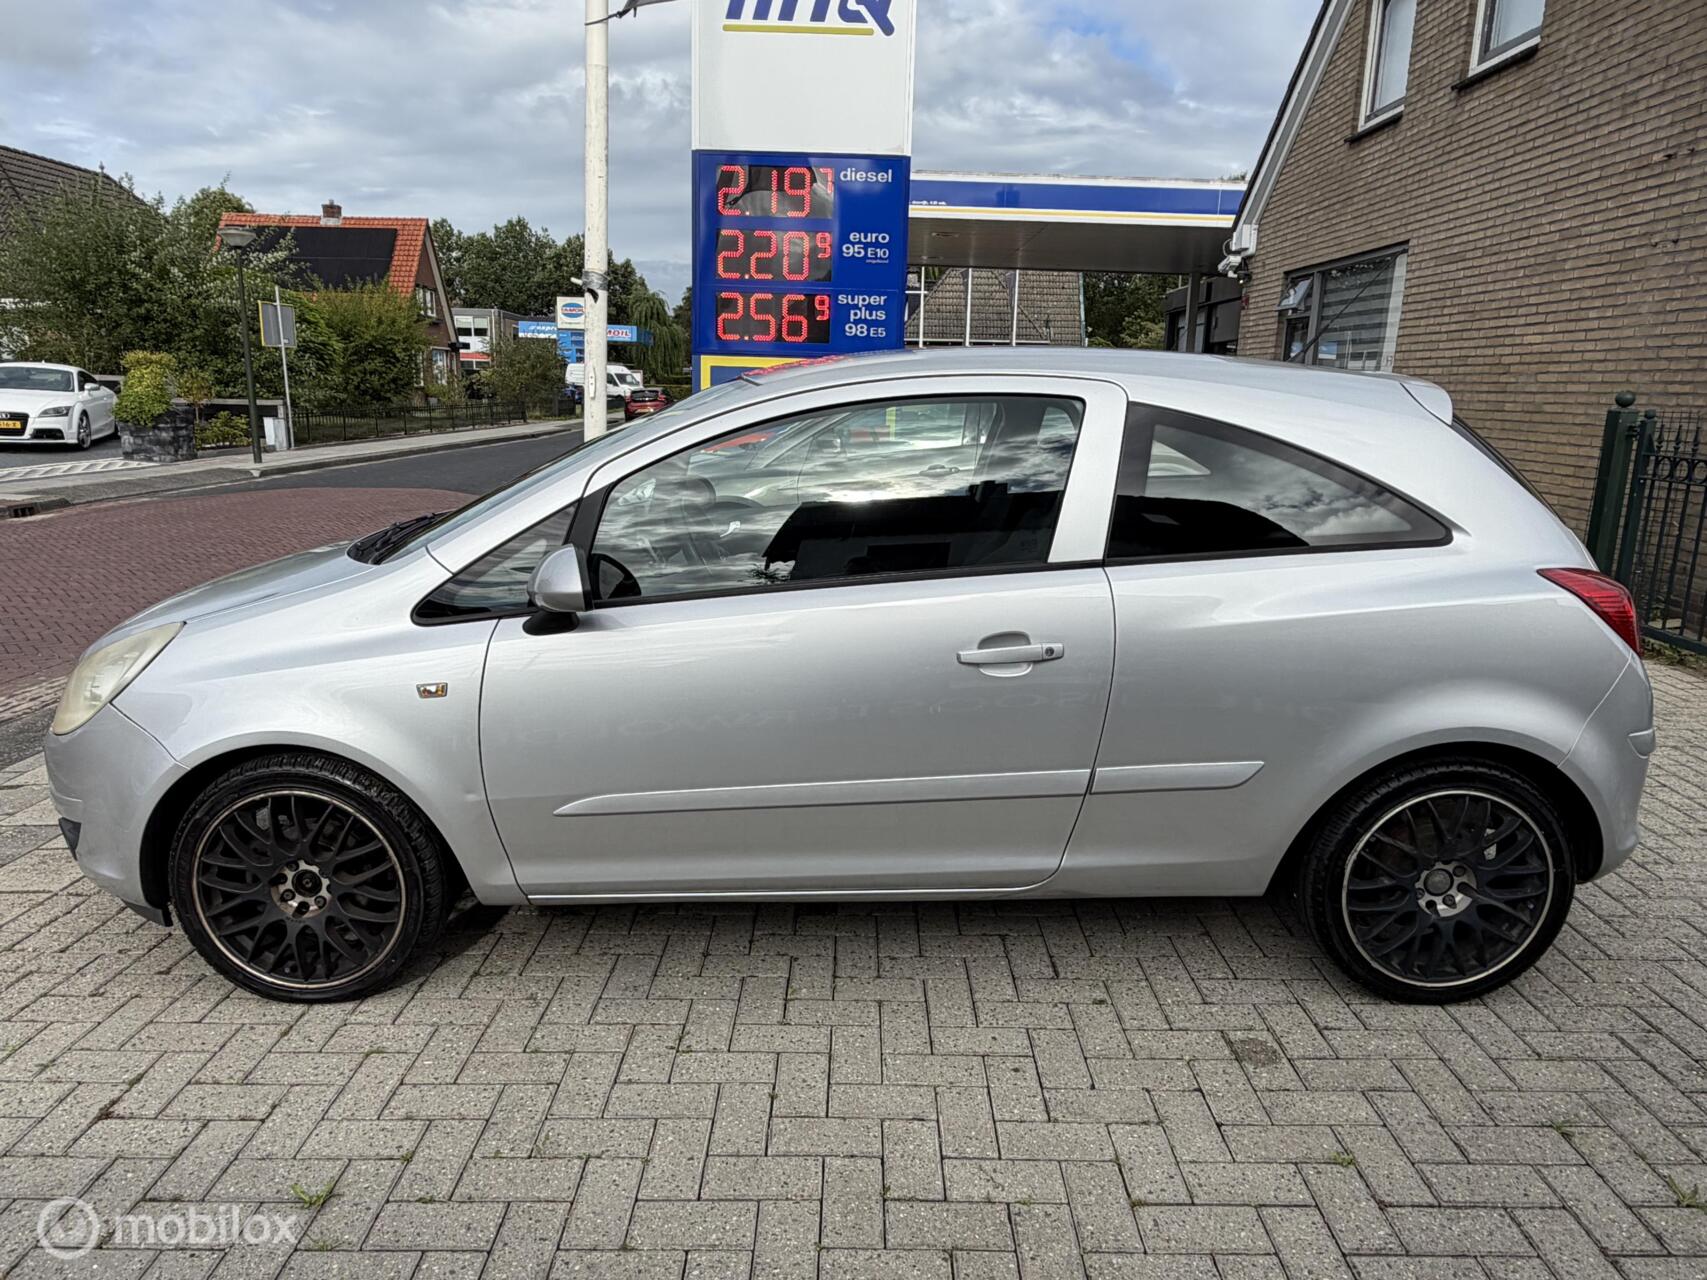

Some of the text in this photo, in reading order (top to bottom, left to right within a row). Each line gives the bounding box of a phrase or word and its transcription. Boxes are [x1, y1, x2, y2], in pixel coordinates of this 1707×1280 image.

[839, 167, 893, 183] diesel
[849, 231, 890, 244] euro
[842, 243, 889, 259] 95 E10
[838, 294, 888, 308] super
[850, 306, 886, 322] plus
[845, 323, 886, 338] 98 E5
